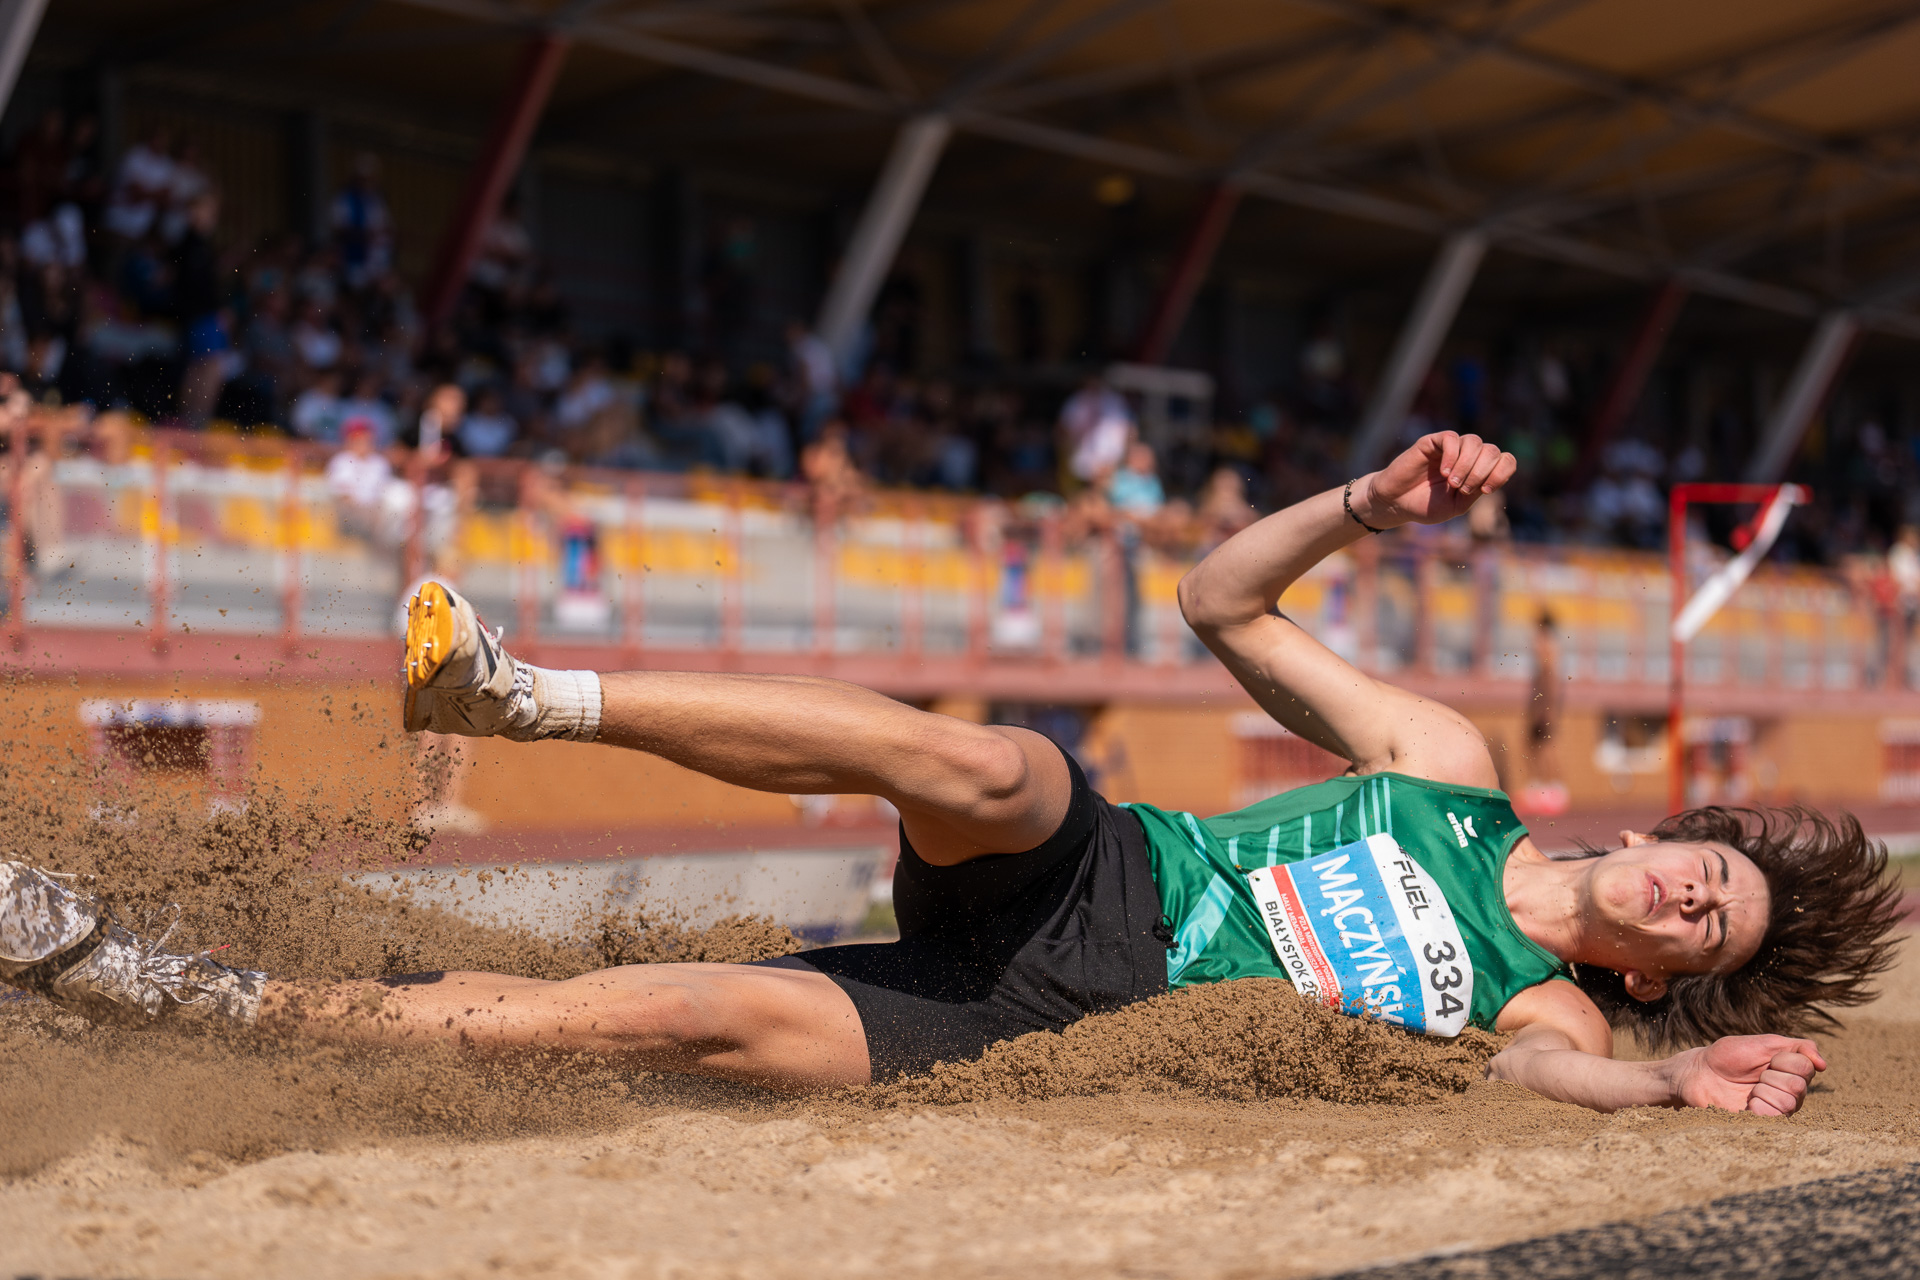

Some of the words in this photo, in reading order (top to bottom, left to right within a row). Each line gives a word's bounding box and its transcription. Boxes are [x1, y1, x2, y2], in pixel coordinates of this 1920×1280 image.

[1446, 811, 1469, 848] erima
[1298, 915, 1309, 932] PZLA
[1393, 860, 1430, 921] FUEL
[1265, 900, 1310, 978] BIAŁYSTOK
[1280, 893, 1293, 912] MAŁY
[1288, 911, 1305, 946] MEMORIAŁ
[1302, 943, 1320, 970] JANUSZA
[1311, 853, 1407, 1024] MĄCZYŃSK
[1423, 940, 1464, 1019] 334
